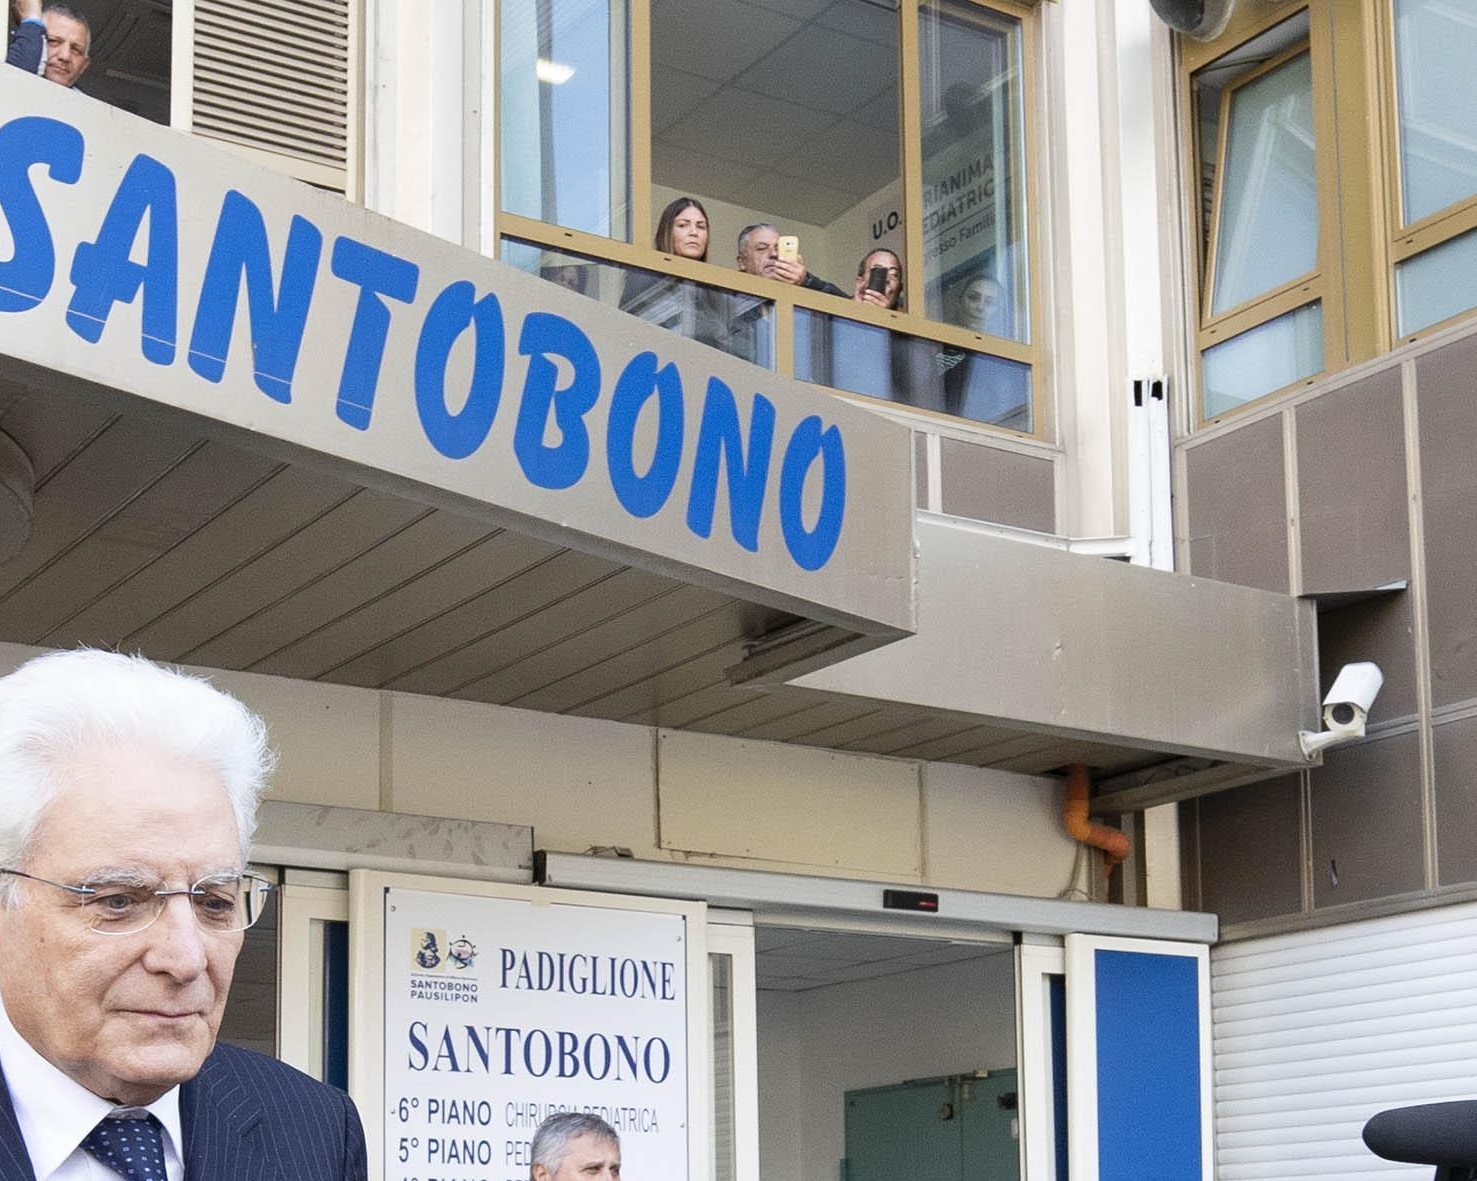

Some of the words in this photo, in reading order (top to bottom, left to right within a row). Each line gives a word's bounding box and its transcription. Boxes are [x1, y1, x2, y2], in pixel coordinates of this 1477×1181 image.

[873, 211, 902, 240] U.O.
[410, 979, 478, 993] SANTOBONO
[499, 948, 675, 1001] PADIGLIONE
[410, 989, 478, 1003] PAUSILIPON
[408, 1021, 670, 1083] SANTOBONO
[398, 1097, 419, 1123] 6°
[427, 1098, 491, 1126] PIANO
[398, 1137, 419, 1163] 5°
[427, 1138, 491, 1166] PIANO
